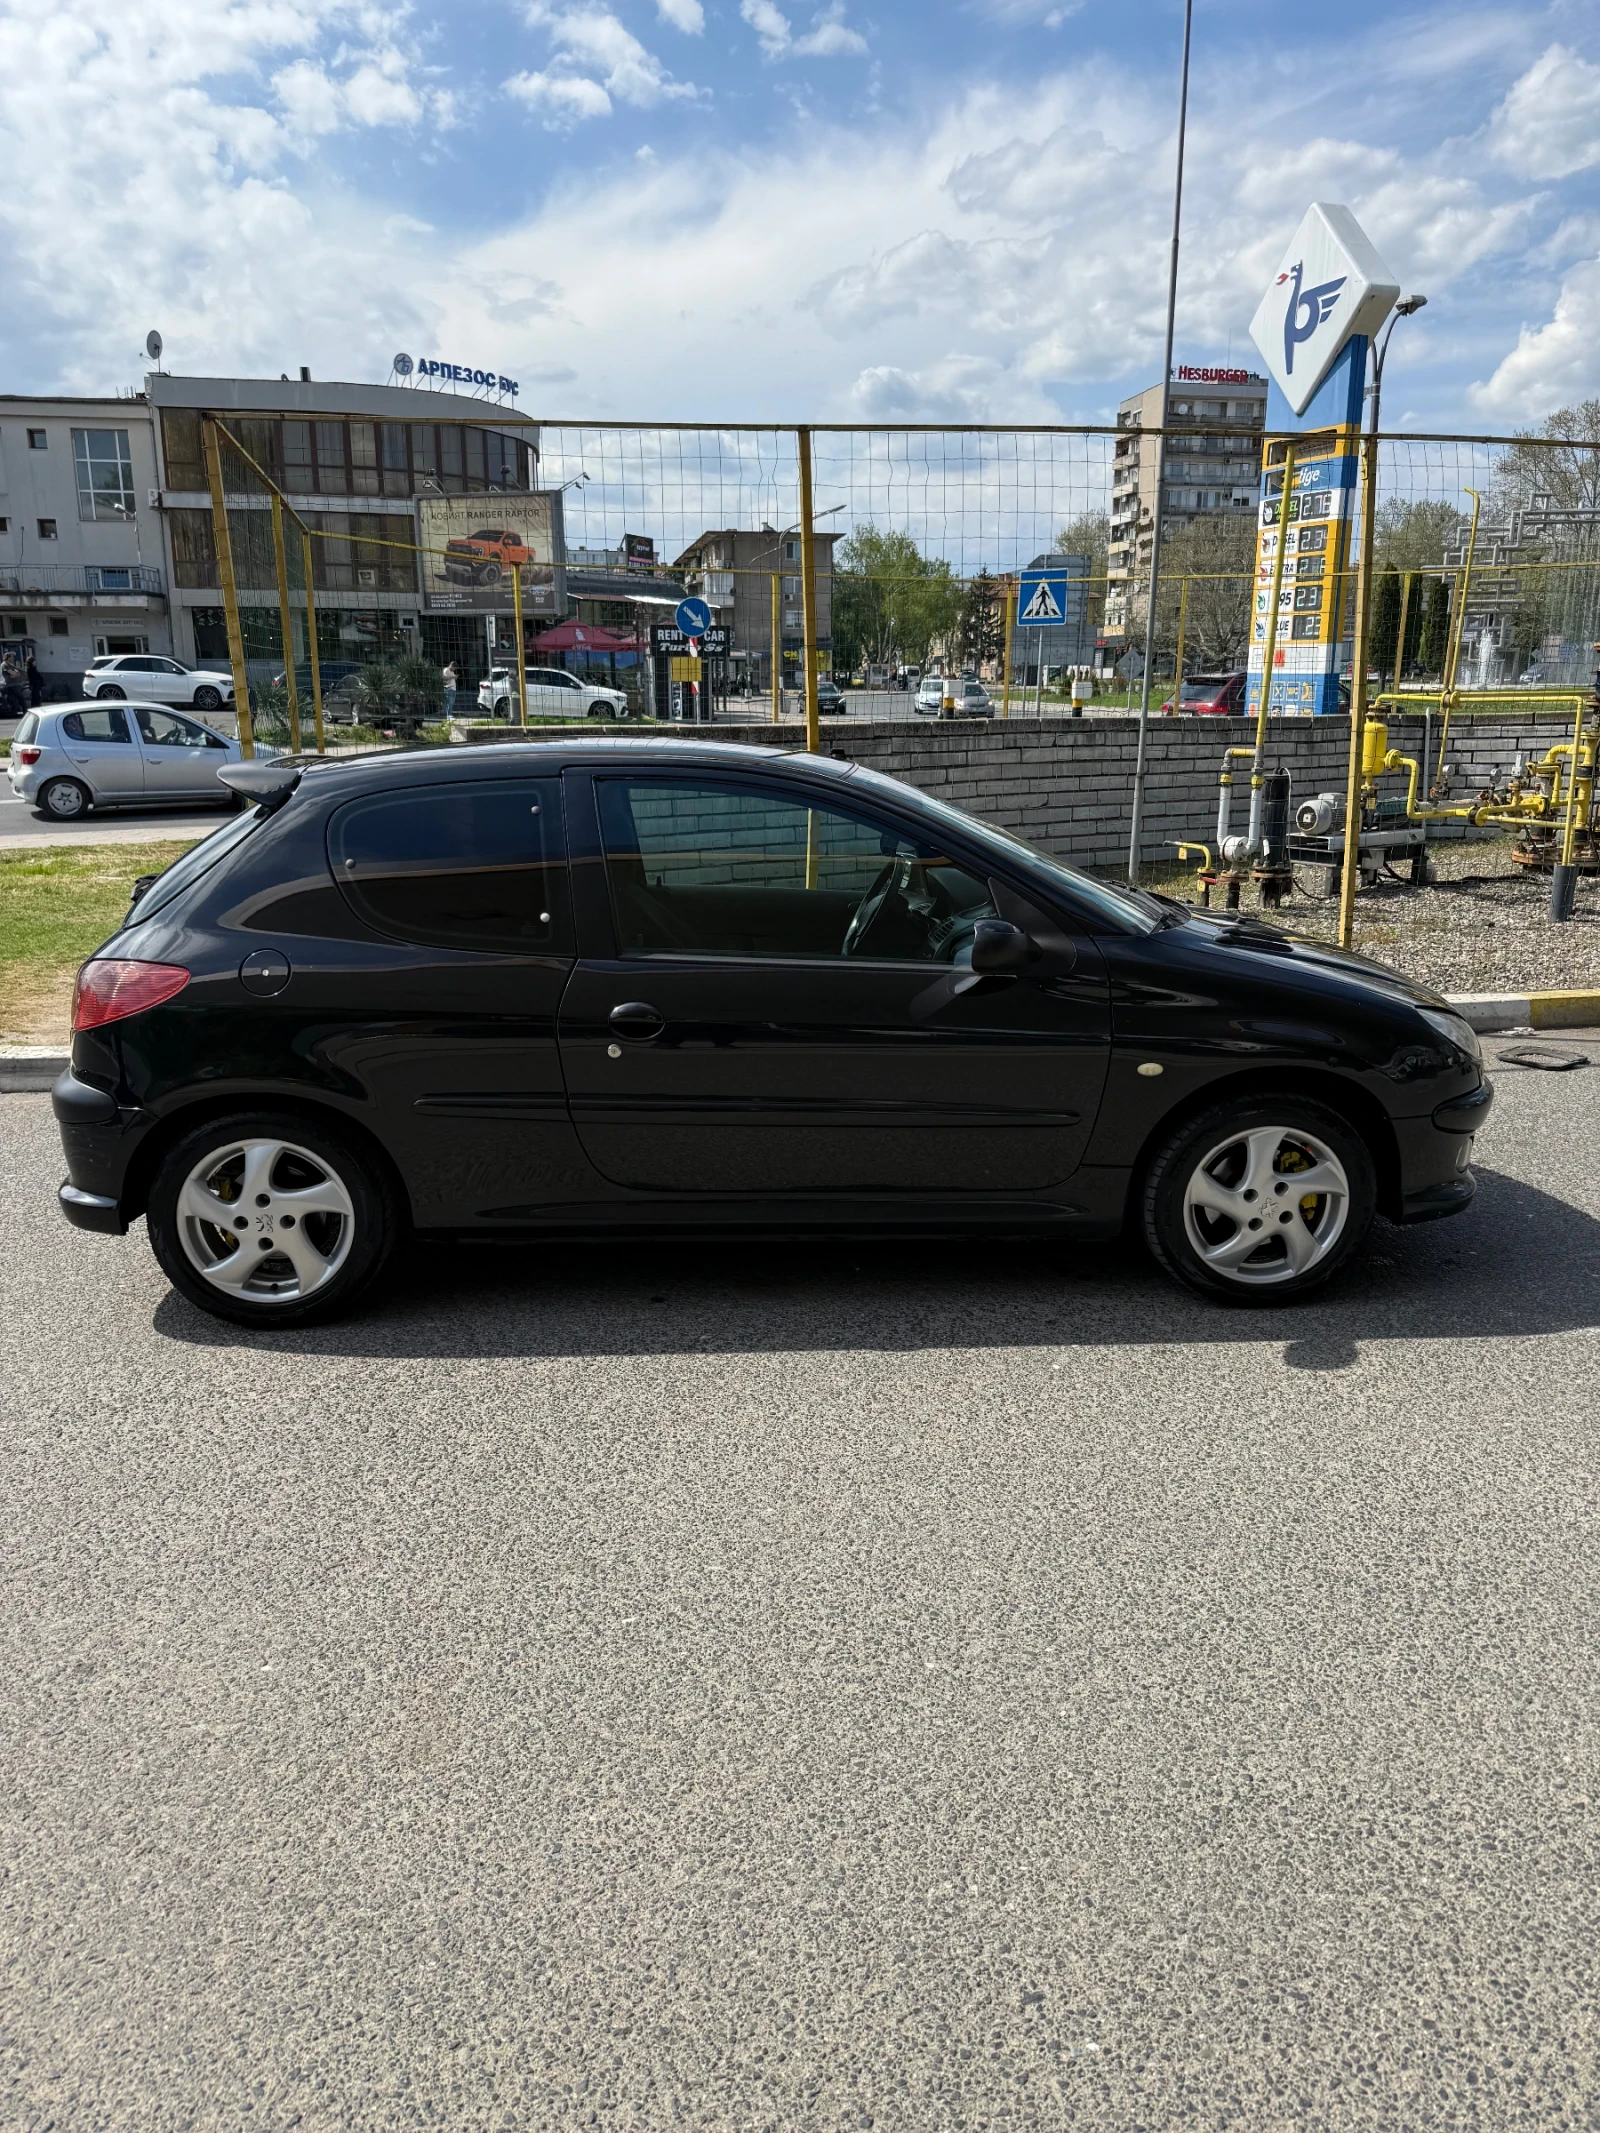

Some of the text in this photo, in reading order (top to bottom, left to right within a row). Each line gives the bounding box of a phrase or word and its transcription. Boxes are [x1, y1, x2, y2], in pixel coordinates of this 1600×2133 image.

[418, 358, 496, 387] АРПЕЗОС
[1178, 365, 1249, 384] HESBURGER
[431, 509, 540, 520] НОВИЯТ RANGER RAPTOR
[657, 629, 725, 642] RENT CAR
